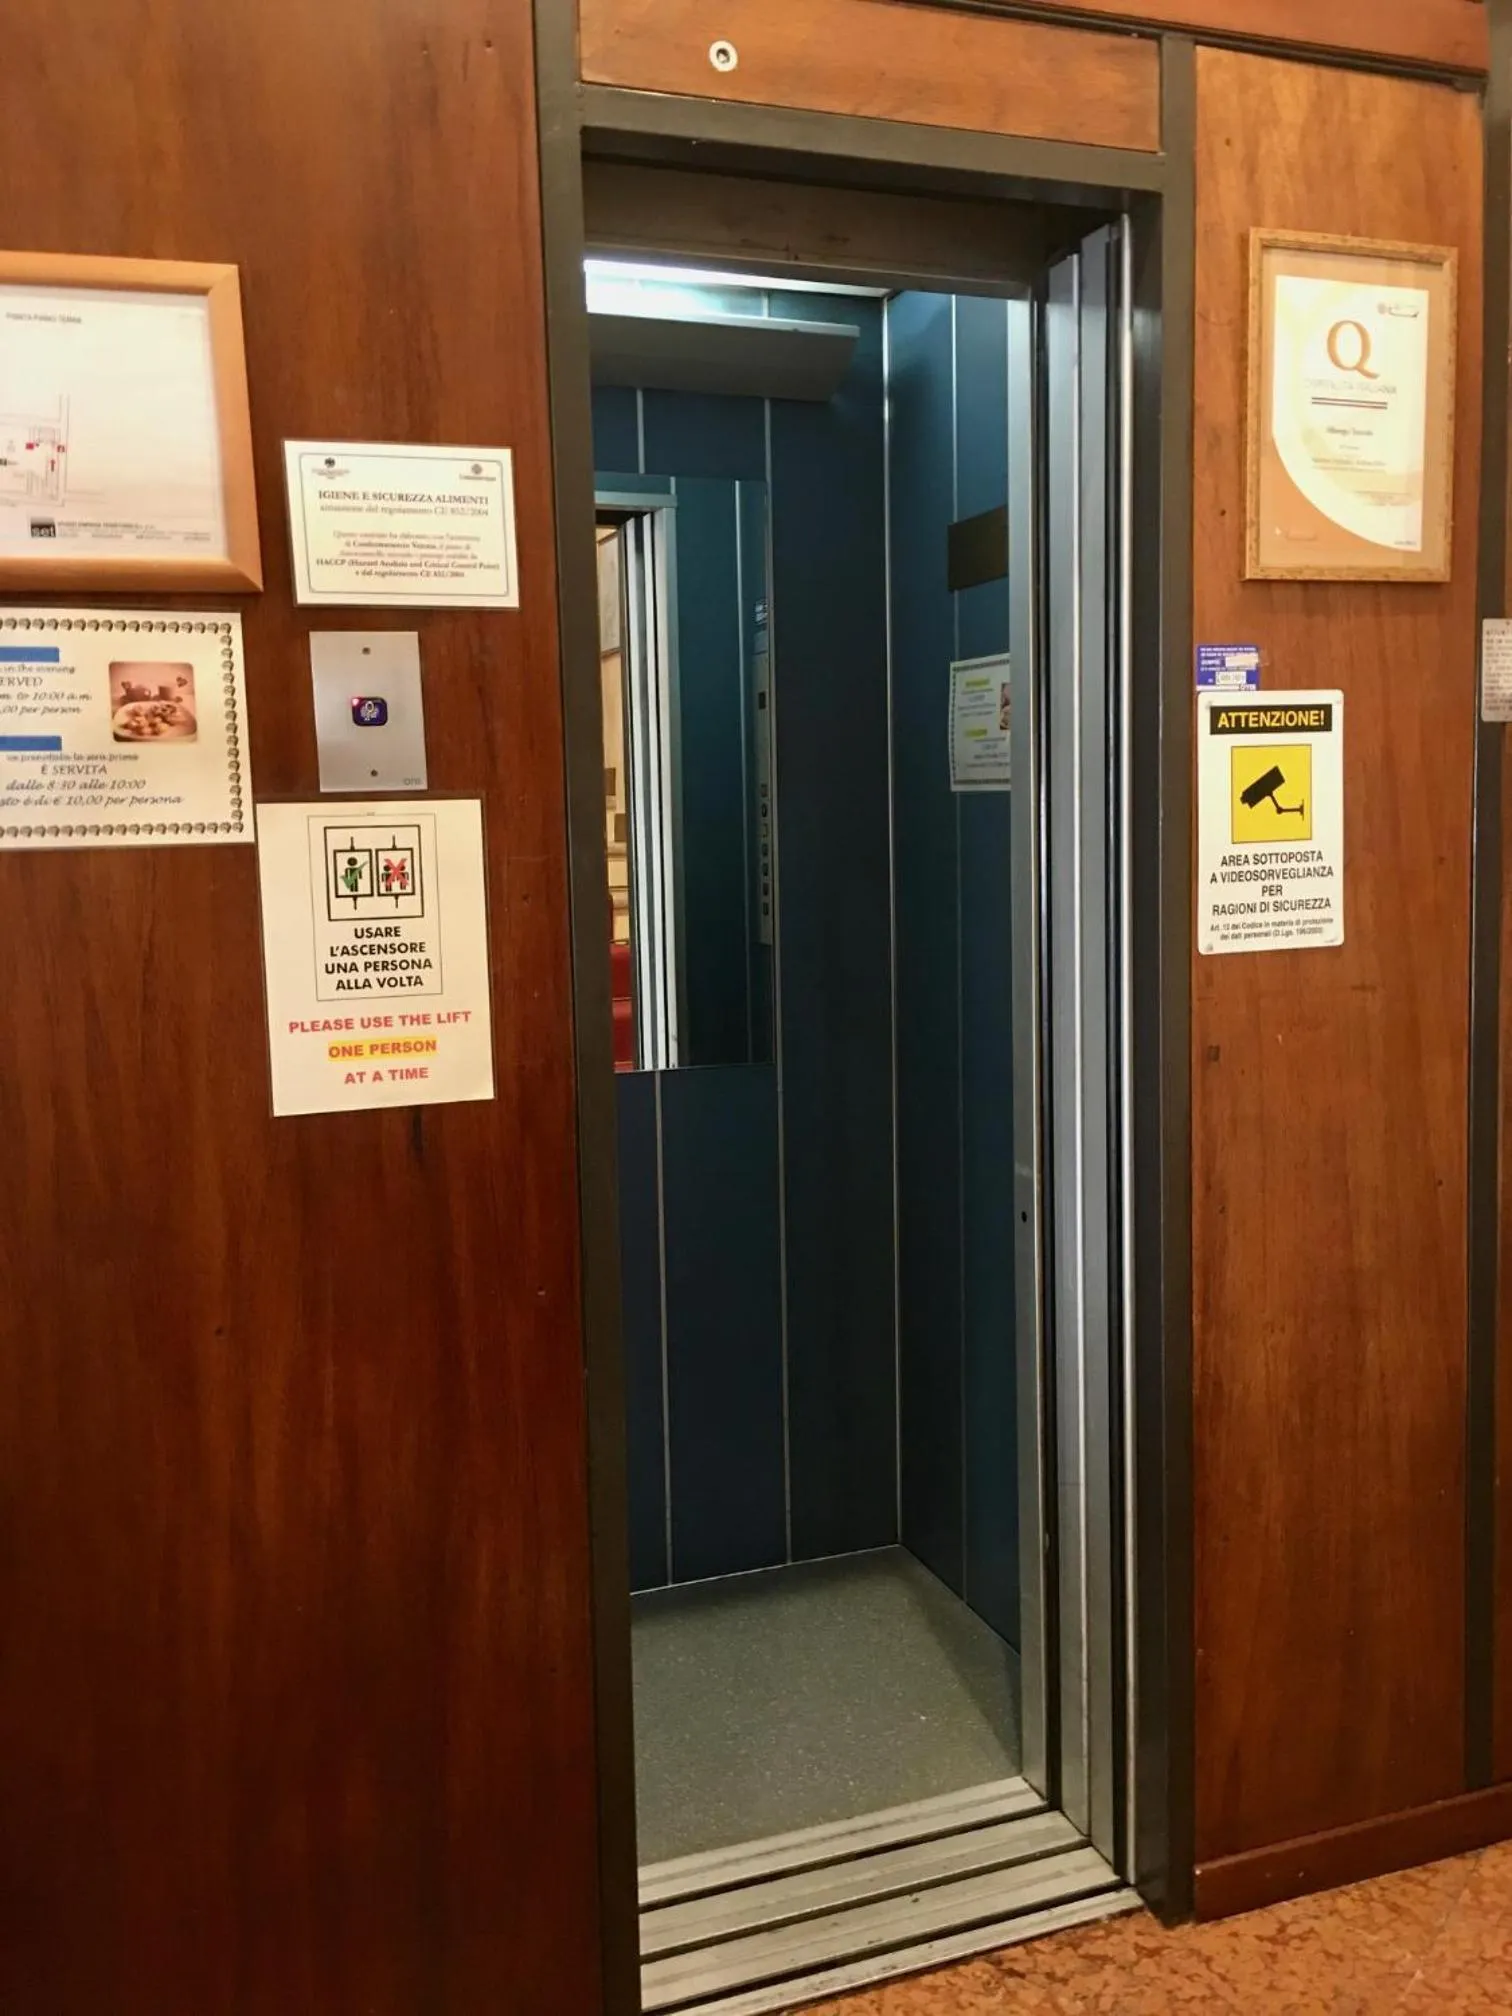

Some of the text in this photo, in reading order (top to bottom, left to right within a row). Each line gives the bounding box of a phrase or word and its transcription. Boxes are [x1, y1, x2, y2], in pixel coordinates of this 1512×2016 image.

[1327, 320, 1380, 379] Q
[318, 490, 489, 505] IGIENE E SICUREZZA ALIMENTI
[19, 706, 38, 716] per
[40, 706, 82, 717] person
[1217, 710, 1325, 728] ATTENZIONE!
[52, 764, 108, 775] SERVITA
[6, 779, 44, 791] dalle
[79, 778, 107, 790] alle
[110, 779, 147, 790] 10:00
[66, 795, 103, 807] 10,00
[104, 796, 128, 812] per
[129, 796, 184, 809] persona
[1220, 850, 1323, 867] AREA SOTTOPOSTA
[1210, 866, 1334, 884] A VIDEOSORVEGLIANZA
[1261, 884, 1283, 897] PER
[1212, 898, 1331, 916] RAGIONI DI SICUREZZA
[354, 926, 401, 939] USARE
[330, 942, 426, 957] L'ASCENSORE
[325, 958, 433, 974] UNA PERSONA
[336, 975, 424, 991] ALLA VOLTA
[288, 1011, 472, 1034] PLEASE USE THE LIFT
[328, 1040, 437, 1059] ONE PERSON
[344, 1067, 429, 1085] AT A TIME
